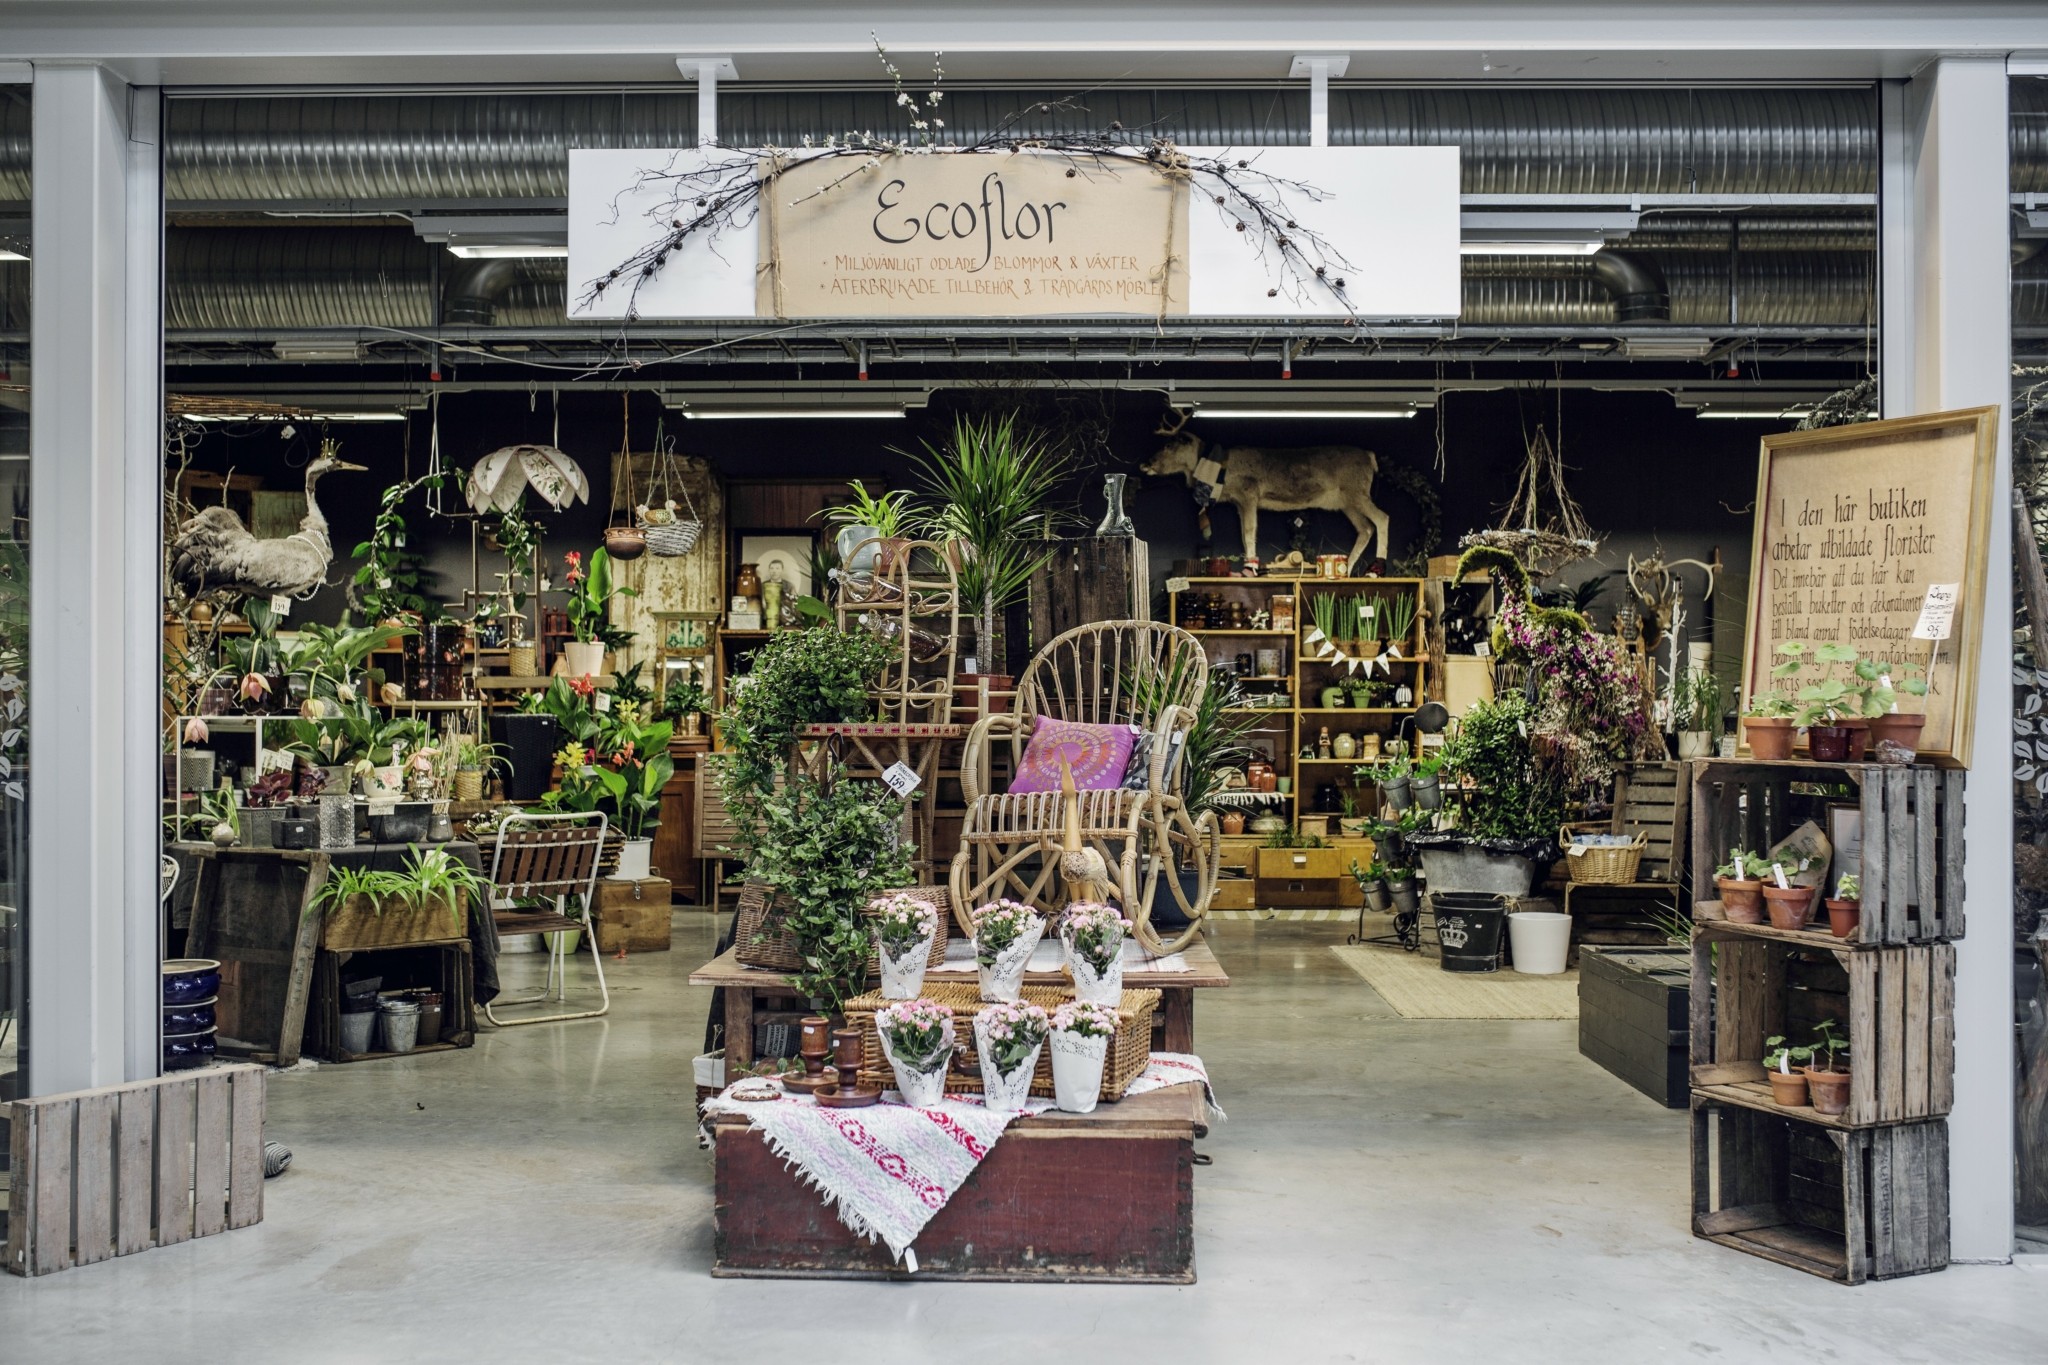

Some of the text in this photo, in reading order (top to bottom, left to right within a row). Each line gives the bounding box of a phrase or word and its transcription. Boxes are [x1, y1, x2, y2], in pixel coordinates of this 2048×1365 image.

[873, 172, 1067, 273] Ecoflor
[835, 253, 1139, 273] MILJÖVÄNLIGT ODLADE BLOMMOR & VÄXTER
[830, 274, 940, 300] ÅTERBRUKADE
[945, 277, 1019, 300] TILLBEHÖR
[1024, 278, 1035, 296] &
[1781, 487, 1927, 527] I den här butiken
[1772, 532, 1812, 561] arbetar
[1820, 526, 1873, 560] utbildade
[1773, 559, 1915, 590] Det innebär att du här kan
[1772, 590, 1803, 617] beställa
[1809, 589, 1847, 615] buketter
[1851, 592, 1865, 614] och
[1870, 589, 1924, 614] dekorationer
[1771, 618, 1782, 640] till
[1785, 617, 1810, 640] bland
[1813, 617, 1841, 641] annat
